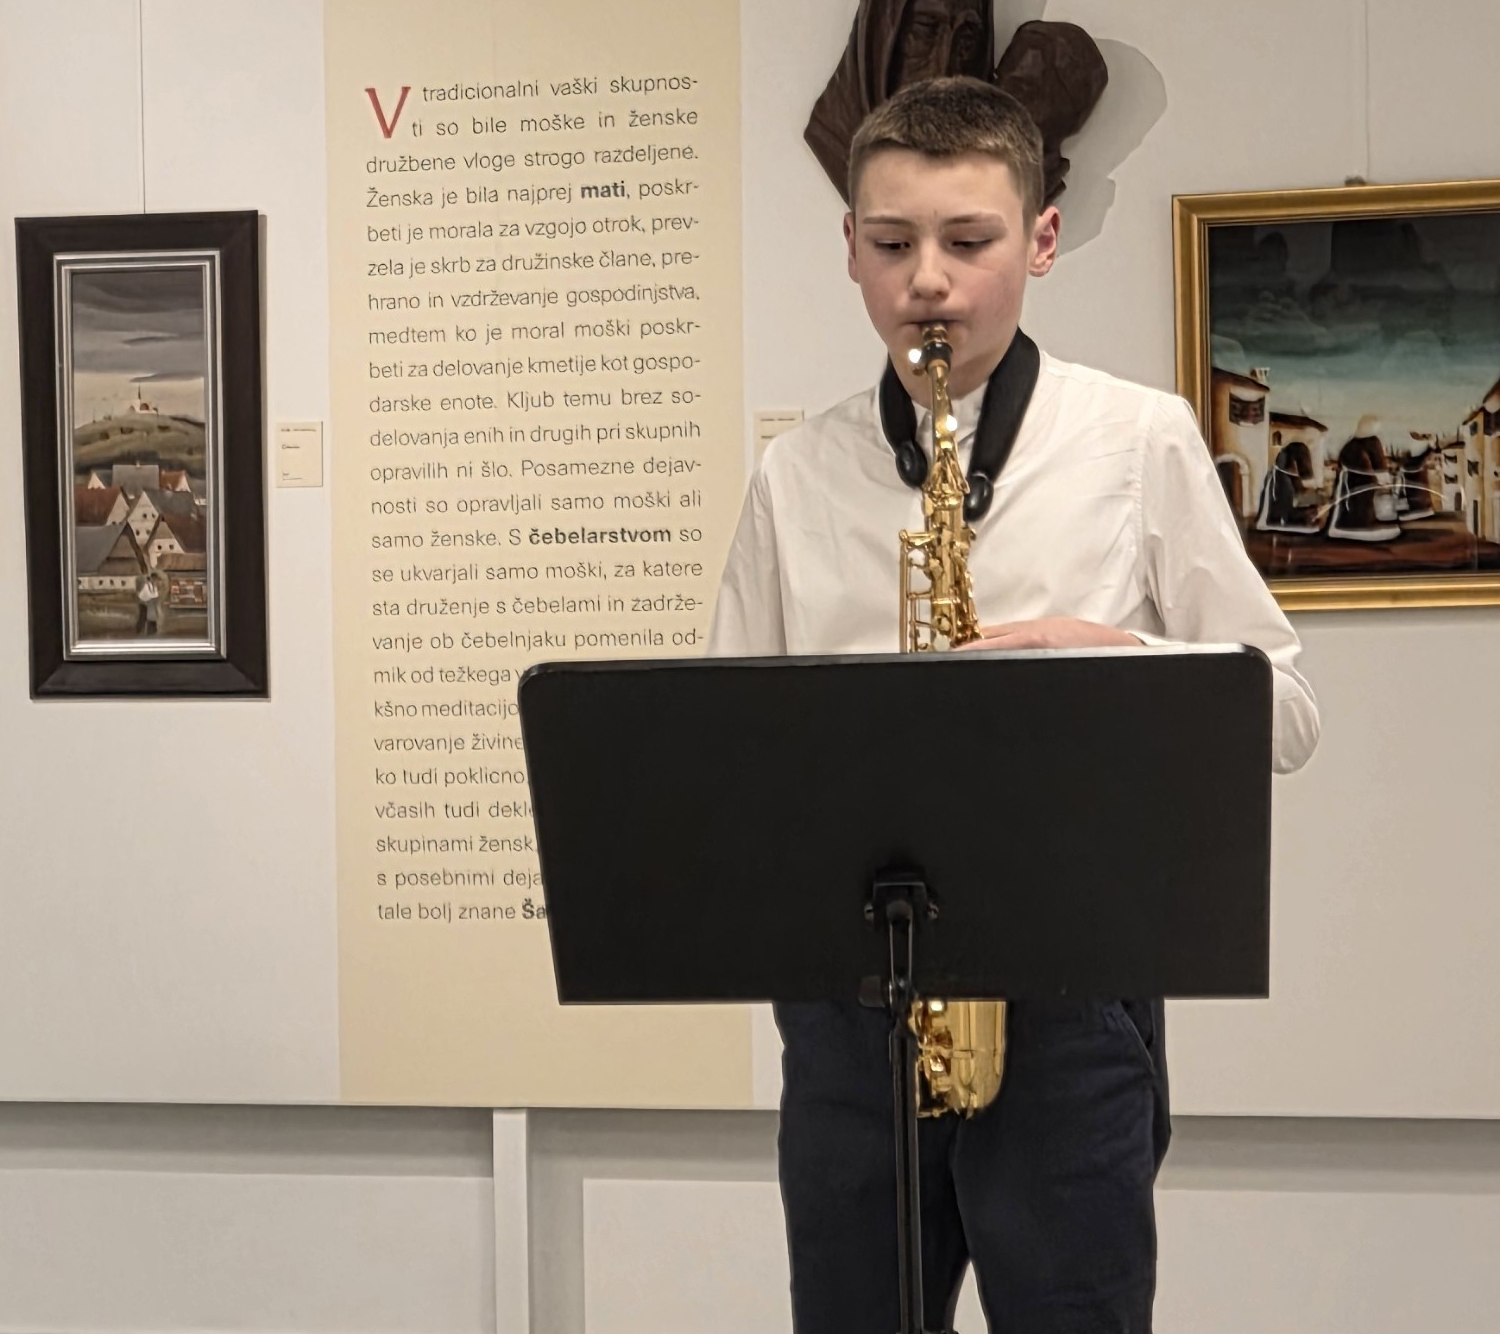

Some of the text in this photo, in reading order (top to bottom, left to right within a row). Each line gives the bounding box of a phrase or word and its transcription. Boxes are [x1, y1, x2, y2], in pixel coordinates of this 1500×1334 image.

[364, 76, 699, 140] V tradicionalni vaški skupnos-
[412, 108, 699, 138] ti so bile moške in ženske
[367, 144, 699, 174] družbene vloge strogo razdeljene.
[366, 178, 700, 210] Ženska je bila najprej mati, poskr-
[367, 224, 402, 243] beti
[406, 224, 424, 245] je
[429, 221, 494, 240] morala
[499, 224, 520, 238] za
[525, 217, 587, 240] vzgojo
[652, 217, 699, 236] prev-
[368, 259, 405, 277] zela
[409, 257, 426, 280] je
[431, 256, 471, 275] skrb
[476, 259, 497, 273] za
[502, 252, 595, 272] družinske
[662, 252, 700, 270] pre-
[368, 294, 421, 311] hrano
[429, 291, 444, 309] in
[451, 287, 559, 309] vzdrževanje
[369, 317, 701, 346] medtem ko je moral moški poskr-
[370, 354, 701, 379] beti za delovanje kmetije kot gospo-
[370, 394, 432, 413] darske
[507, 391, 555, 413] Kljub
[563, 391, 612, 408] temu
[621, 388, 664, 406] brez
[671, 391, 702, 404] so-
[370, 420, 701, 450] delovanja enih in drugih pri skupnih
[371, 456, 702, 485] opravilih ni šlo. Posamezne dejav-
[372, 489, 701, 516] nosti so opravljali samo moški ali
[372, 526, 703, 549] samo ženske. S čebelarstvom so
[373, 560, 703, 585] se ukvarjali samo moški, za katere
[373, 593, 704, 619] sta druženje s čebelami in zadrže-
[373, 628, 704, 654] vanje ob čebelnjaku pomenila od-
[374, 666, 407, 684] mik
[411, 666, 434, 684] od
[439, 666, 511, 687] težkega
[375, 700, 418, 718] kšno
[374, 735, 466, 755] varovanje
[376, 768, 397, 785] ko
[403, 767, 438, 786] tudi
[375, 800, 534, 819] včasih tudi dekl
[376, 835, 474, 856] skupinami
[377, 873, 387, 886] s
[395, 867, 495, 891] posebnimi
[378, 902, 412, 921] tale
[418, 902, 452, 924] bolj
[459, 906, 517, 921] znane
